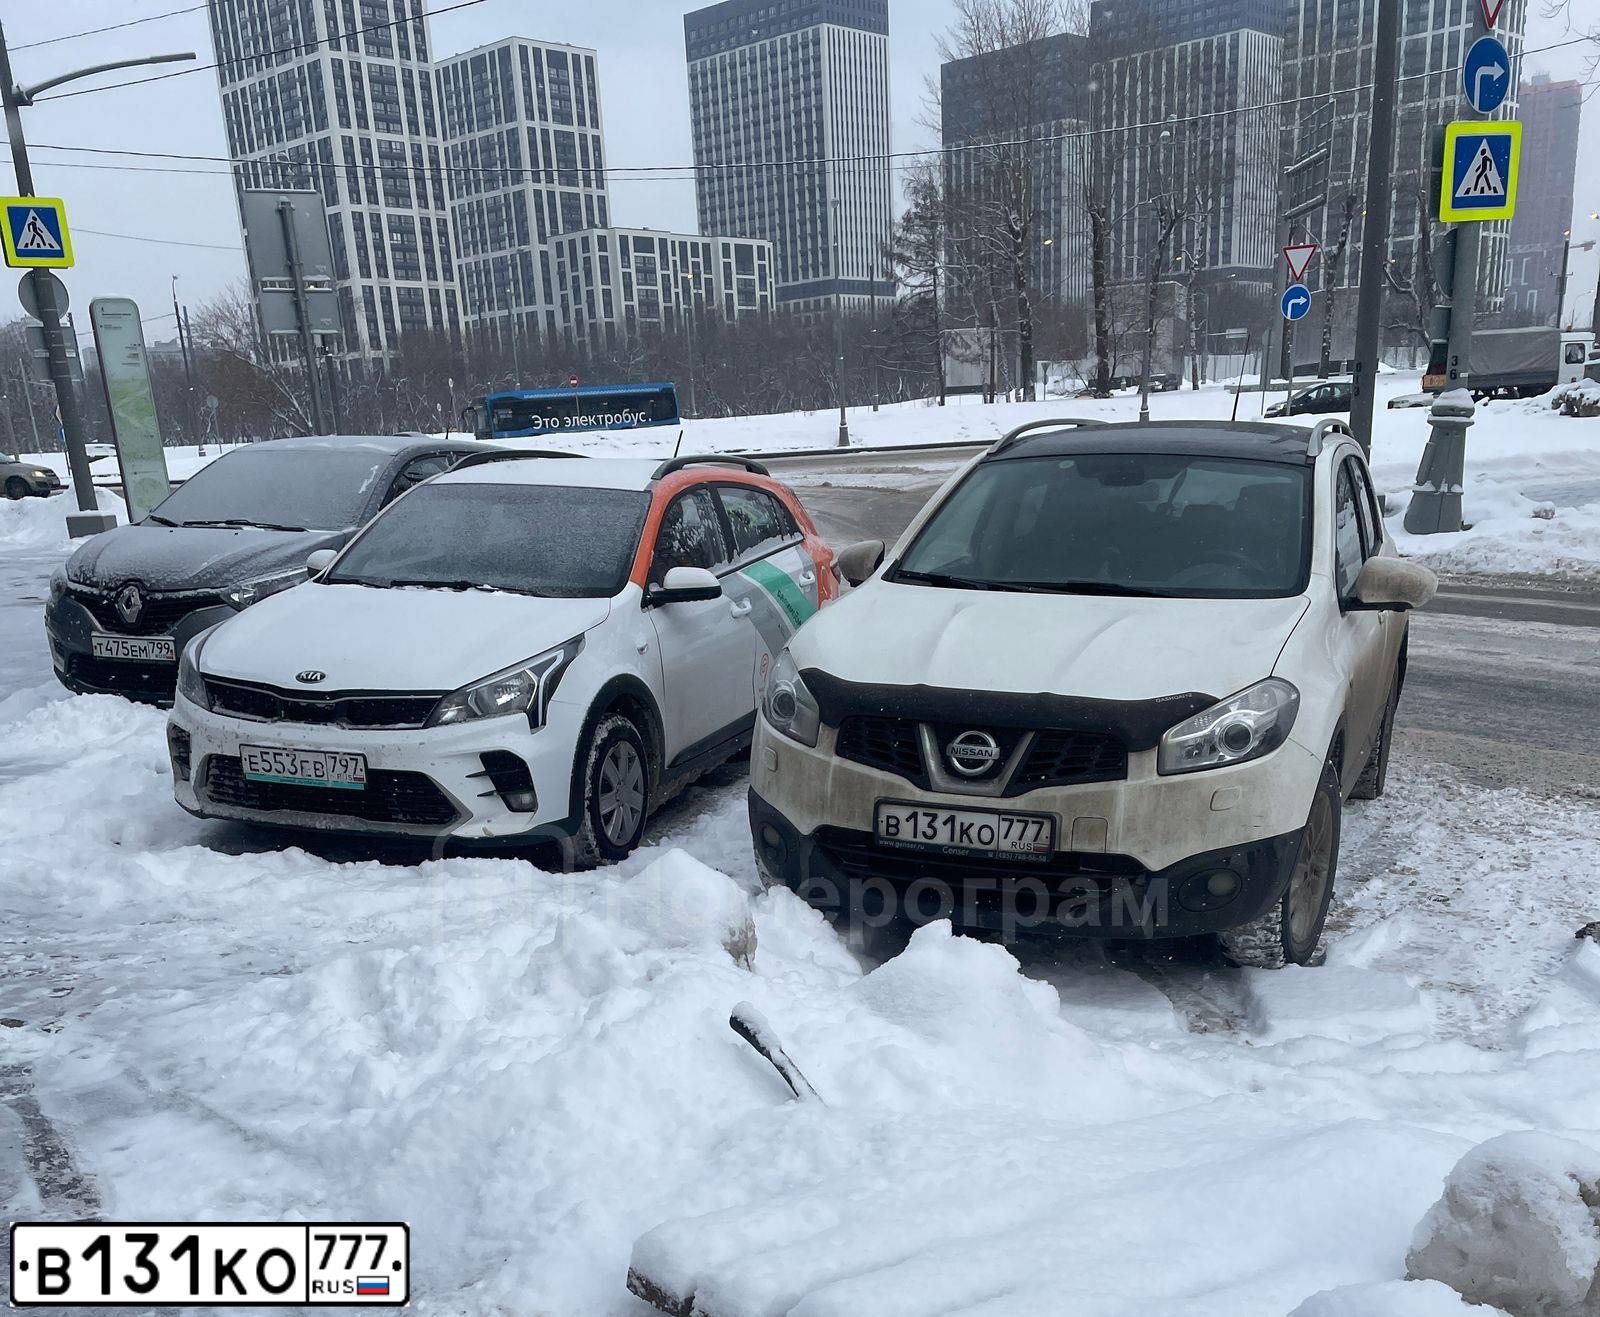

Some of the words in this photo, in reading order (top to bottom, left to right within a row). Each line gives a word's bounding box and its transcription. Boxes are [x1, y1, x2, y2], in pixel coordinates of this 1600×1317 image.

[531, 415, 560, 430] Это
[563, 408, 652, 429] электробус.
[96, 640, 148, 658] Т475ЕМ
[148, 641, 171, 655] 799
[298, 671, 321, 681] KIA
[950, 746, 993, 757] NISSAN
[327, 755, 359, 776] 797
[885, 811, 995, 846] В131КО
[1001, 817, 1046, 842] 777
[879, 839, 925, 850] www.genser.ru
[1011, 841, 1033, 851] RUS
[942, 846, 969, 856] Genser
